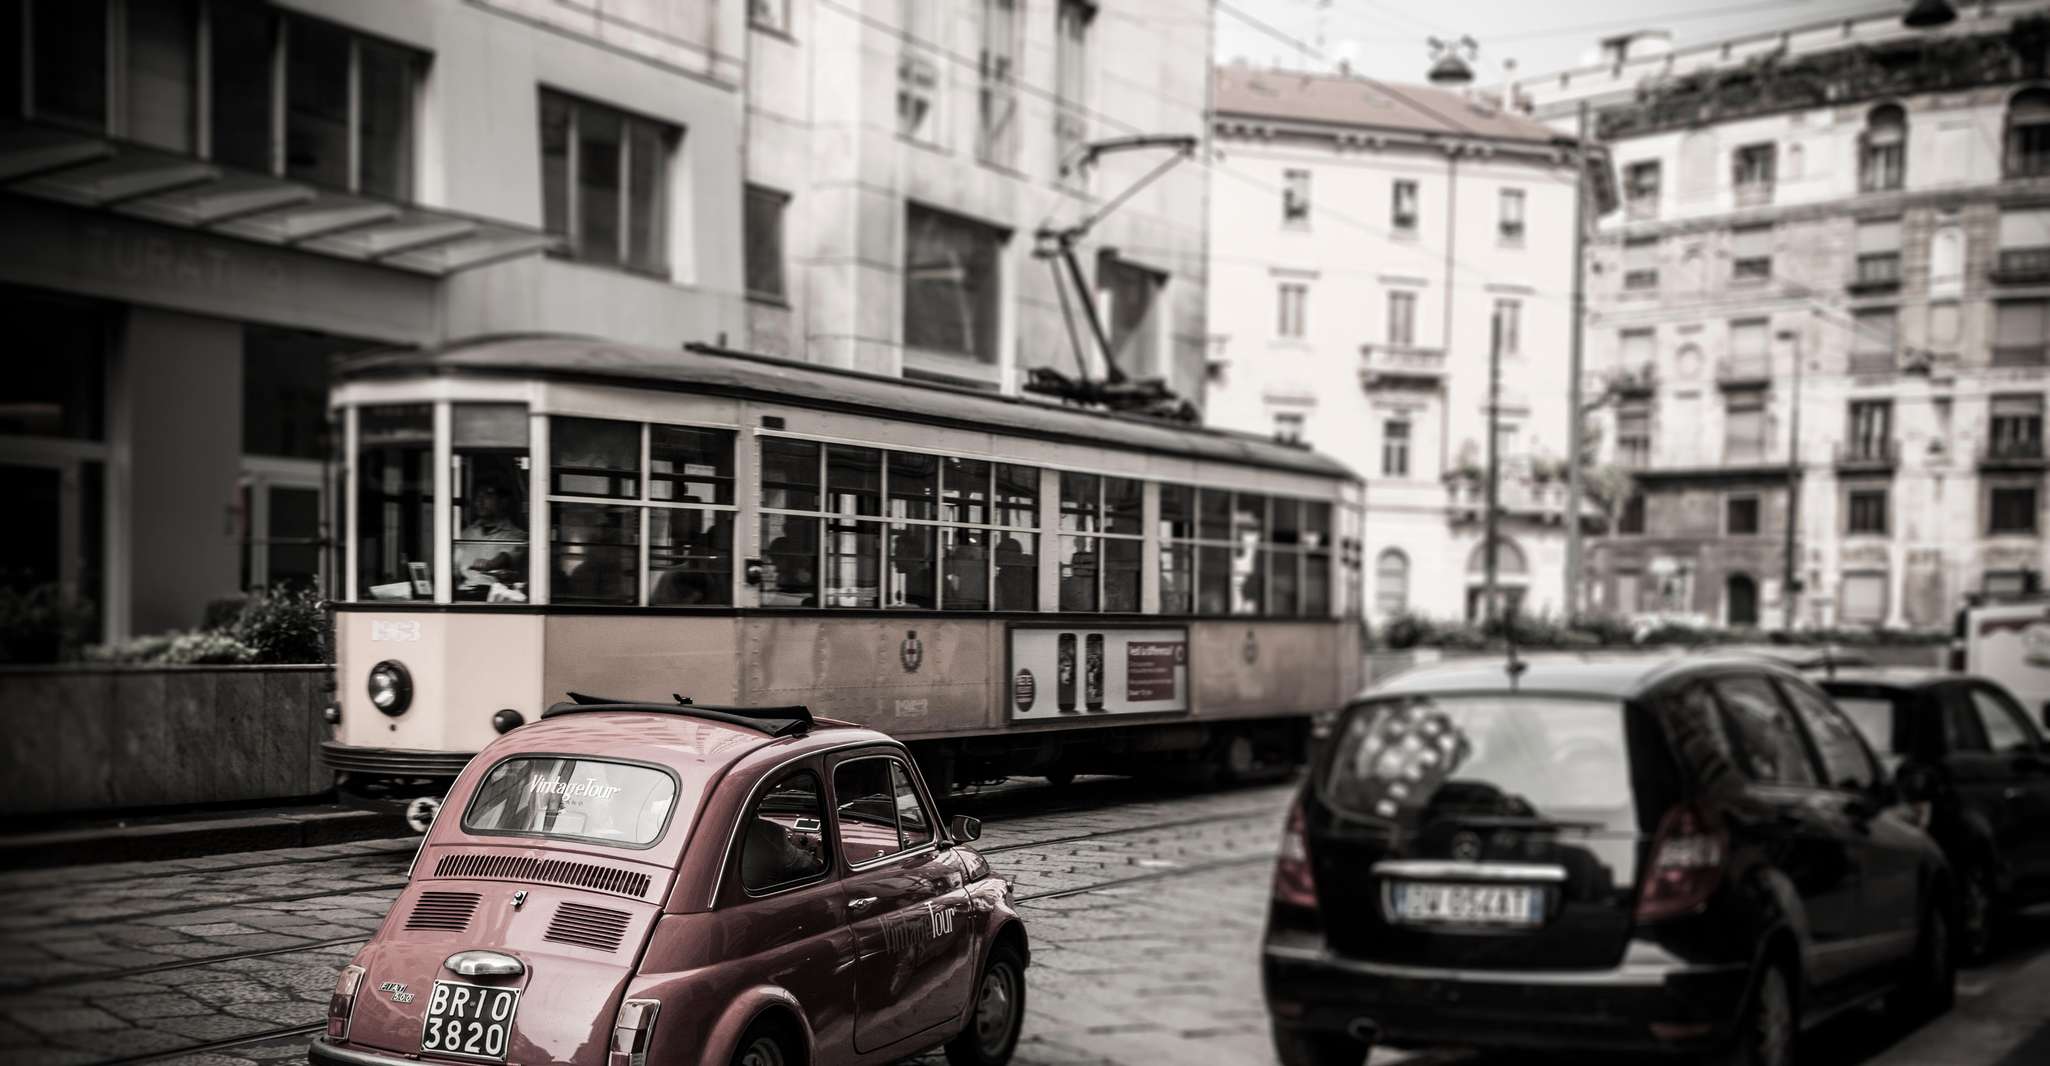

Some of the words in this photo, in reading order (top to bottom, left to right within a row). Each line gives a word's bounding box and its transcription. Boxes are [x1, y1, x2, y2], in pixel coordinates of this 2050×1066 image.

[380, 982, 407, 993] FIAT
[392, 992, 414, 1003] 500
[424, 1017, 505, 1055] 3820
